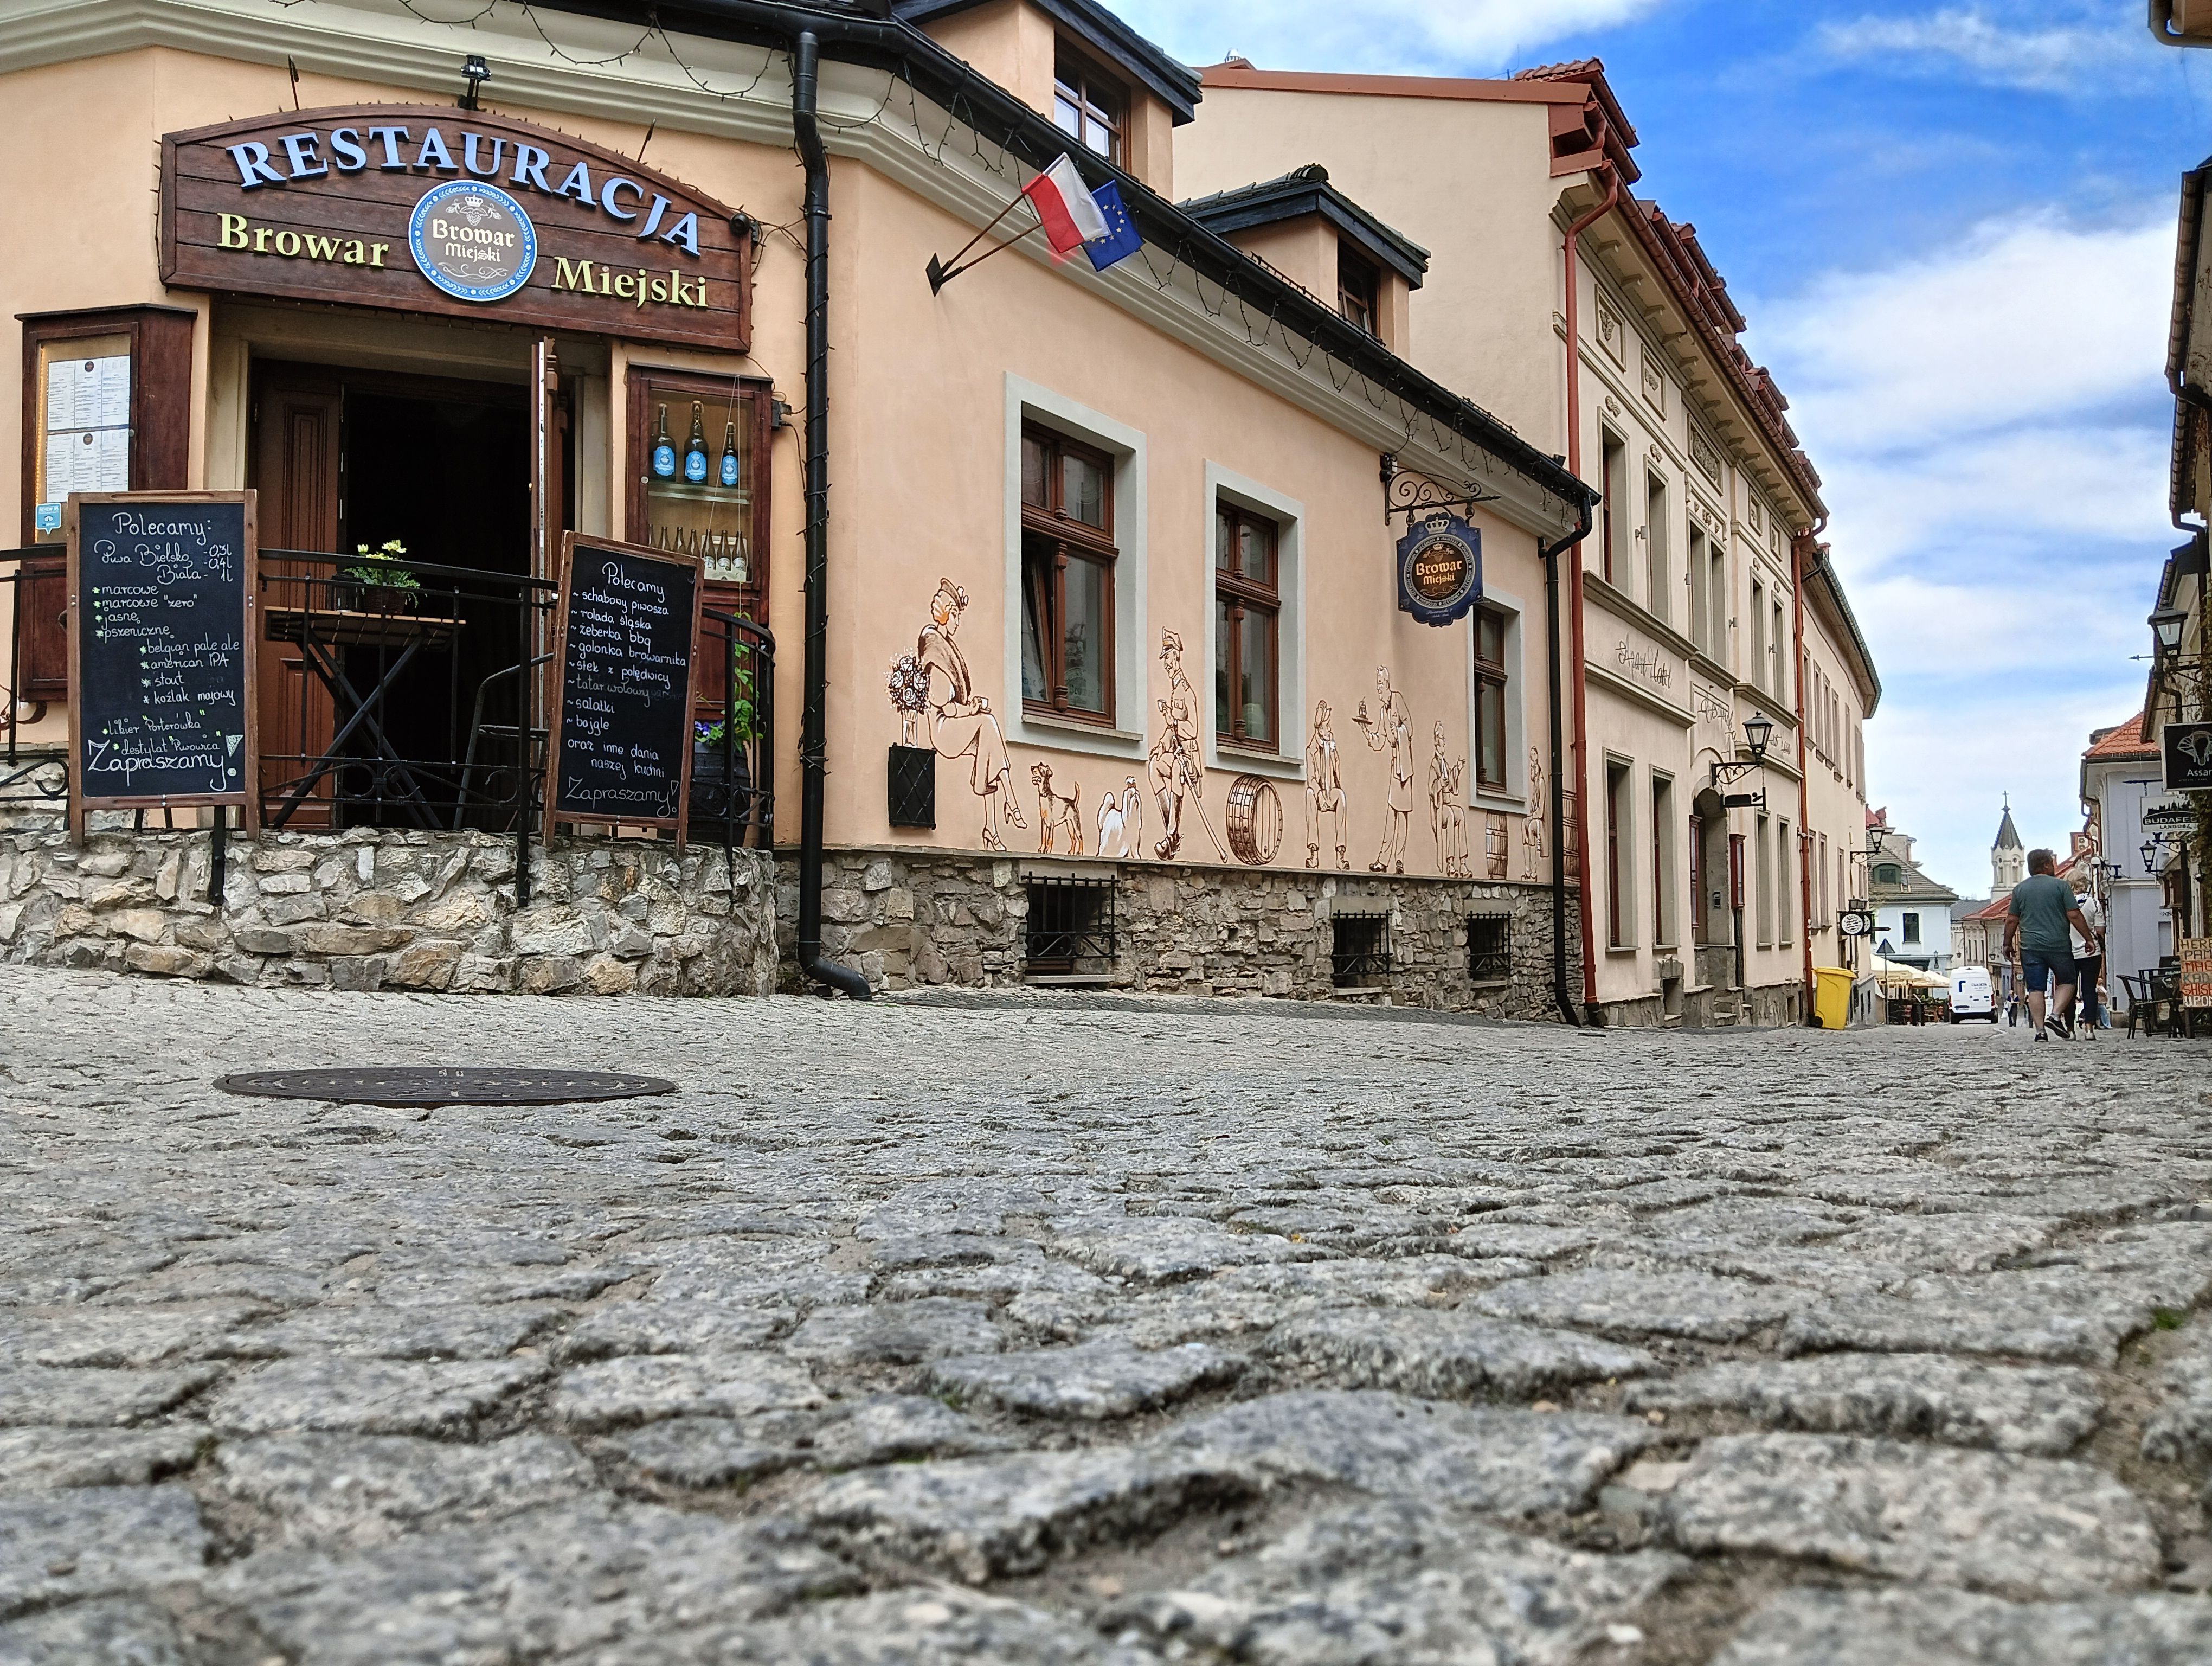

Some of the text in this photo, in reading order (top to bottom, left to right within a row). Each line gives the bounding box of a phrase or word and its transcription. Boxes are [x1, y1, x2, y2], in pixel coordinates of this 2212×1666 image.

[226, 125, 701, 257] RESTAURACJA
[433, 219, 515, 248] Browar
[217, 212, 708, 308] Browar Miejski
[445, 242, 501, 262] Miejski
[112, 512, 211, 546] Polecamy:
[94, 540, 132, 563] Piwa
[1416, 560, 1462, 576] Browar
[1423, 573, 1455, 585] Miejski
[102, 585, 158, 595] marcowe
[602, 562, 665, 603] Polecamy
[102, 599, 158, 608] marcowe
[582, 587, 669, 615] schabowy piwosza
[580, 608, 652, 630] rolada śląska
[147, 632, 240, 662] belgian pale ale
[580, 623, 651, 653] żeberka bbq
[151, 651, 229, 668] american IPA
[578, 640, 686, 667] golonka browarnika
[155, 671, 184, 686] stout
[577, 661, 599, 672] stek
[622, 664, 671, 689] polędwicy
[154, 687, 235, 706] koźlak majowy
[576, 673, 603, 691] tatar
[607, 677, 650, 708] wołowy
[108, 718, 139, 735] likier
[576, 715, 609, 736] bajgle
[121, 738, 168, 759] destylat
[568, 739, 659, 760] oraz inne dania
[88, 734, 243, 791] Zapraszamy!
[591, 759, 664, 780] naszej kuchni
[565, 776, 679, 818] Zapraszamy!
[2144, 816, 2197, 824] BUDAFES
